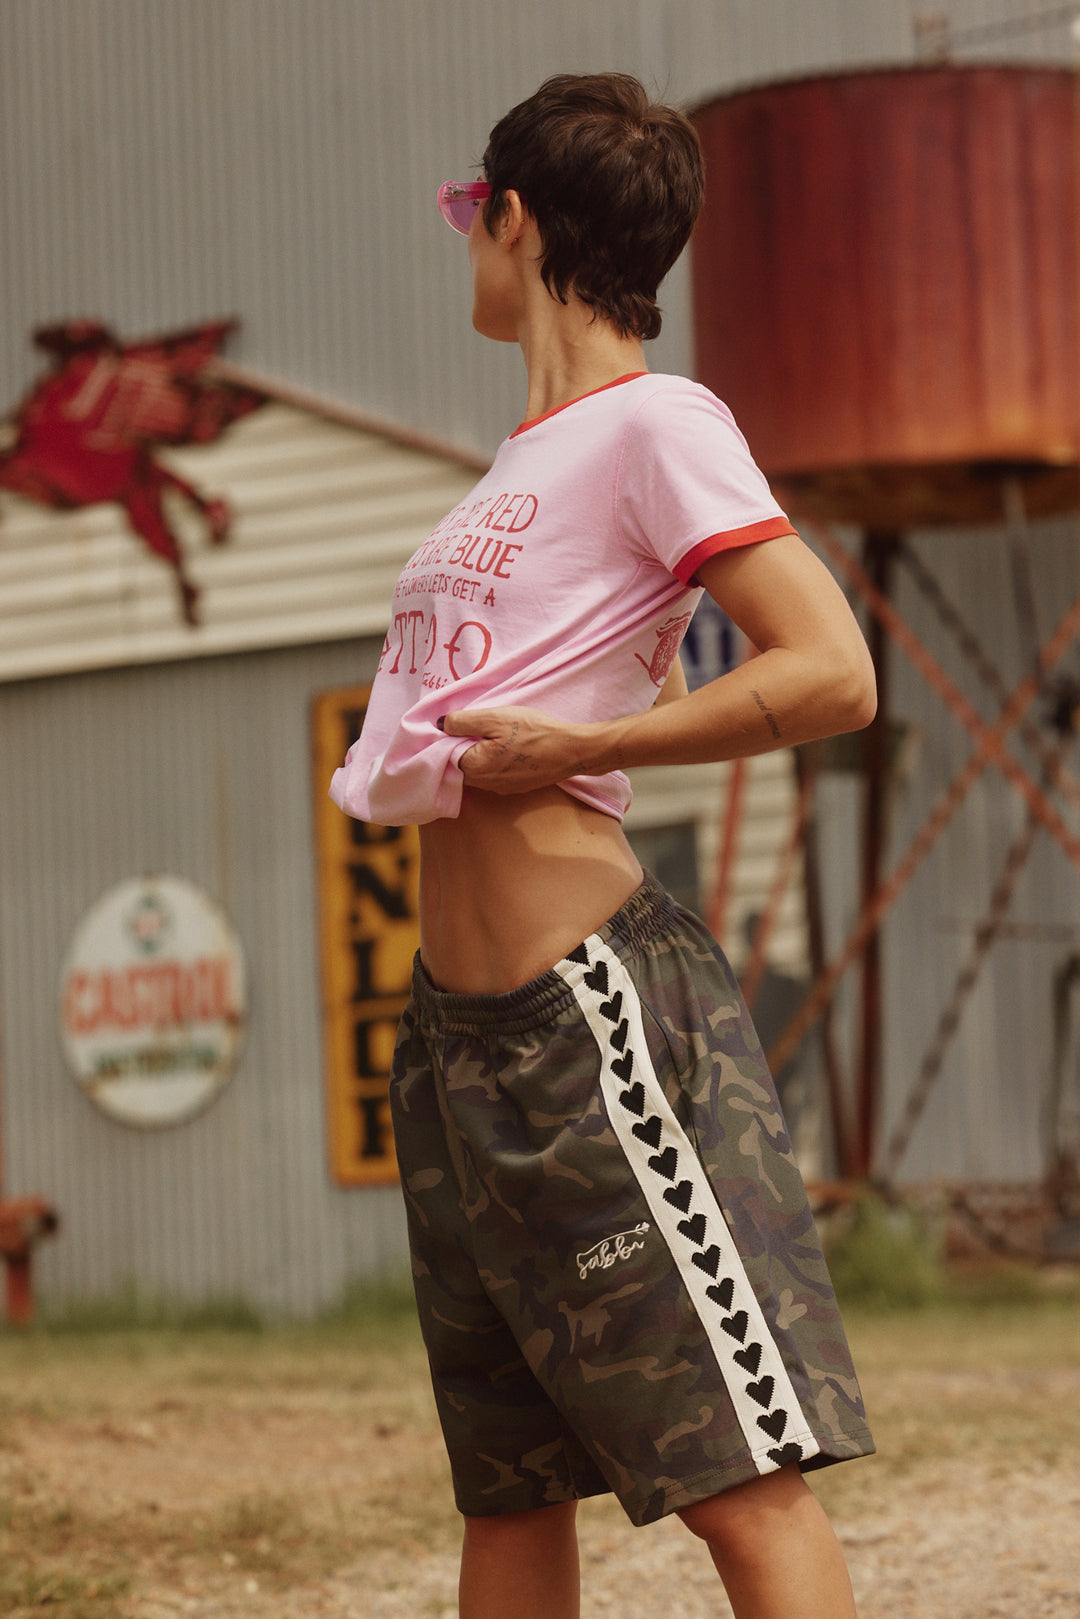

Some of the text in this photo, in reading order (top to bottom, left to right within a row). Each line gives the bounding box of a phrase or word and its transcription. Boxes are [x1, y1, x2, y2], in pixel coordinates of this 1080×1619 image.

[475, 493, 538, 533] RED
[448, 534, 523, 579] BLUE
[452, 577, 480, 601] GET
[483, 588, 496, 606] A
